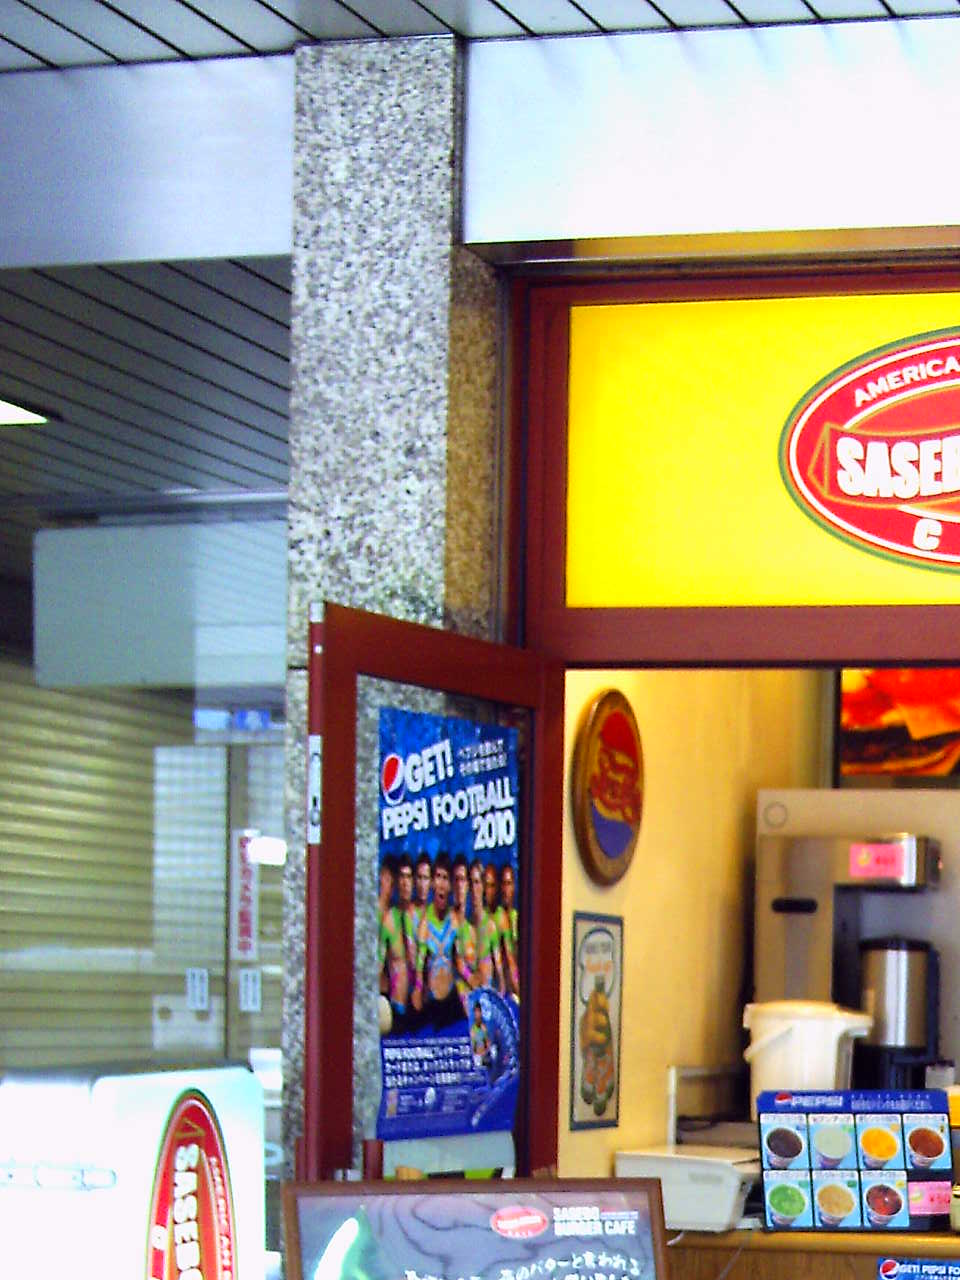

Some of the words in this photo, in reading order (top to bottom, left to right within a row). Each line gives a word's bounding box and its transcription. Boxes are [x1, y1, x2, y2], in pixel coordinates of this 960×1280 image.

[405, 739, 454, 793] GET!
[382, 797, 429, 840] PEPSI
[431, 776, 516, 827] FOOTBALL
[472, 808, 516, 851] 2010
